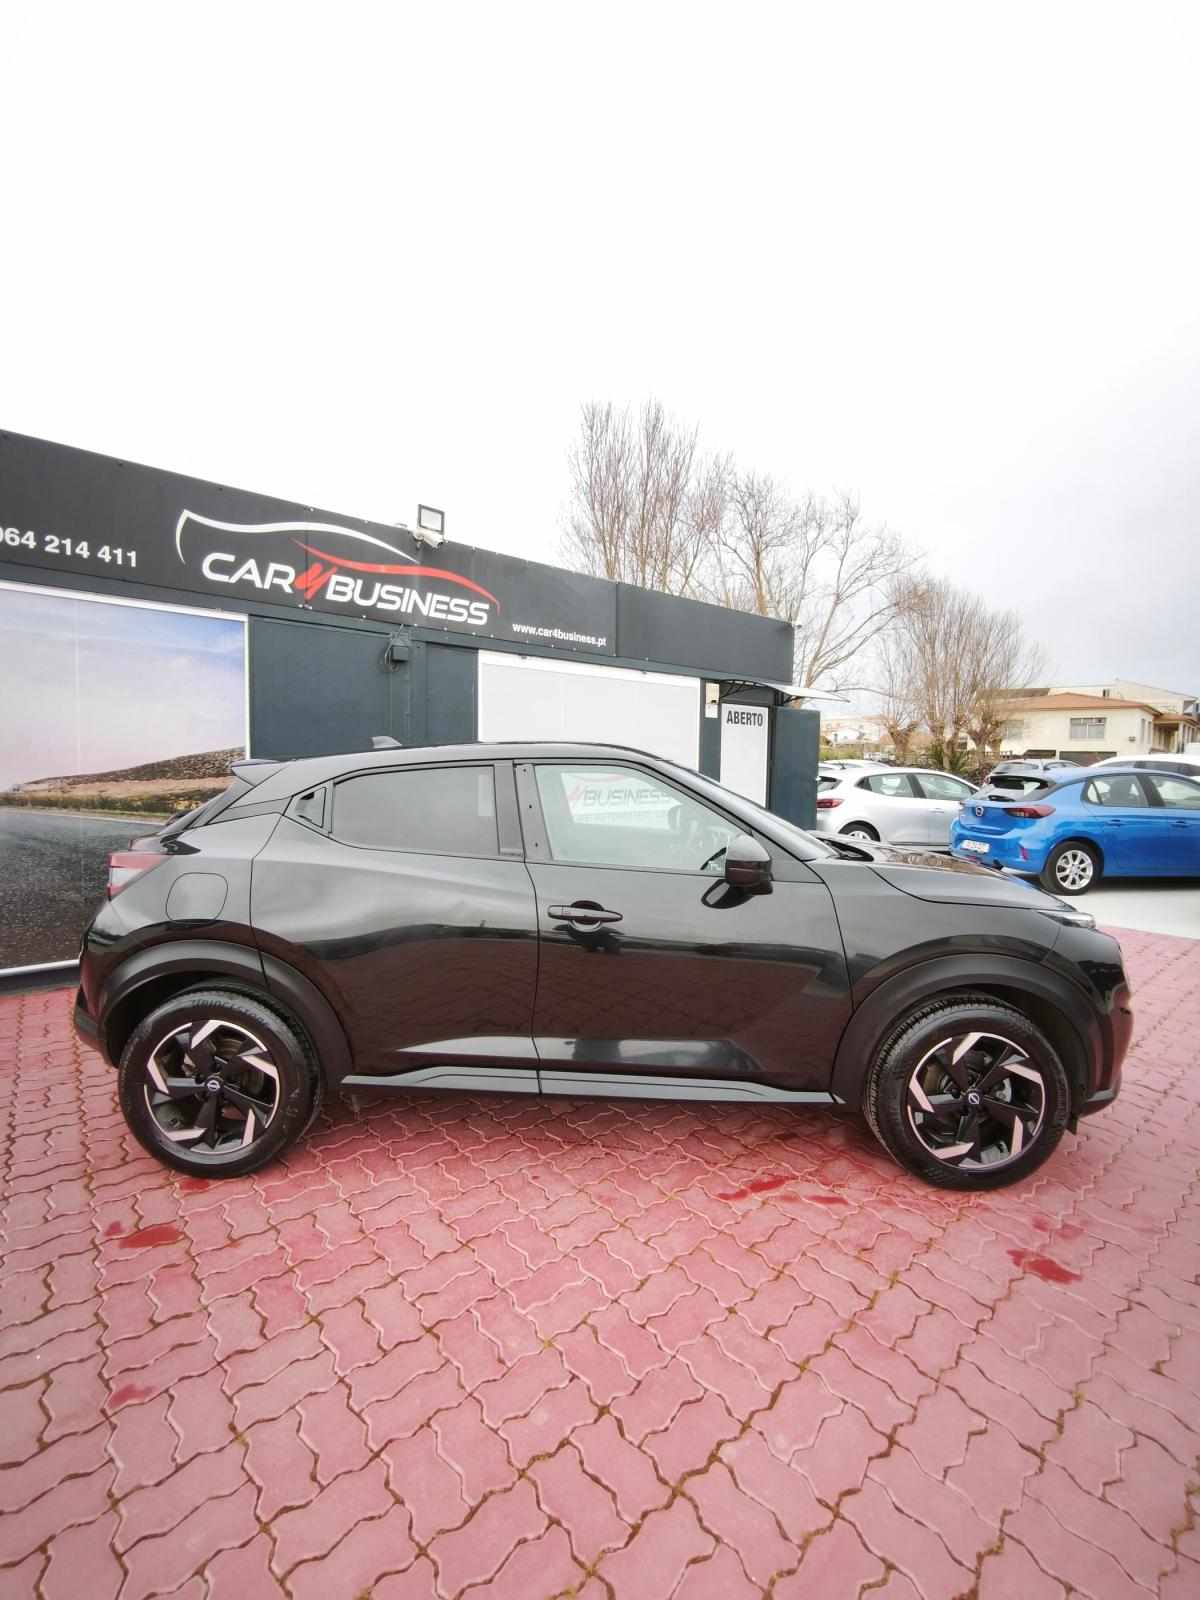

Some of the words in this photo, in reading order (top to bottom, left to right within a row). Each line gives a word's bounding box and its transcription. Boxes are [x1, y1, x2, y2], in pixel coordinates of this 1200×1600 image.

[44, 535, 90, 558] 214
[97, 545, 137, 567] 411
[512, 623, 607, 647] www.car4business.pt
[726, 710, 764, 727] ABERTO
